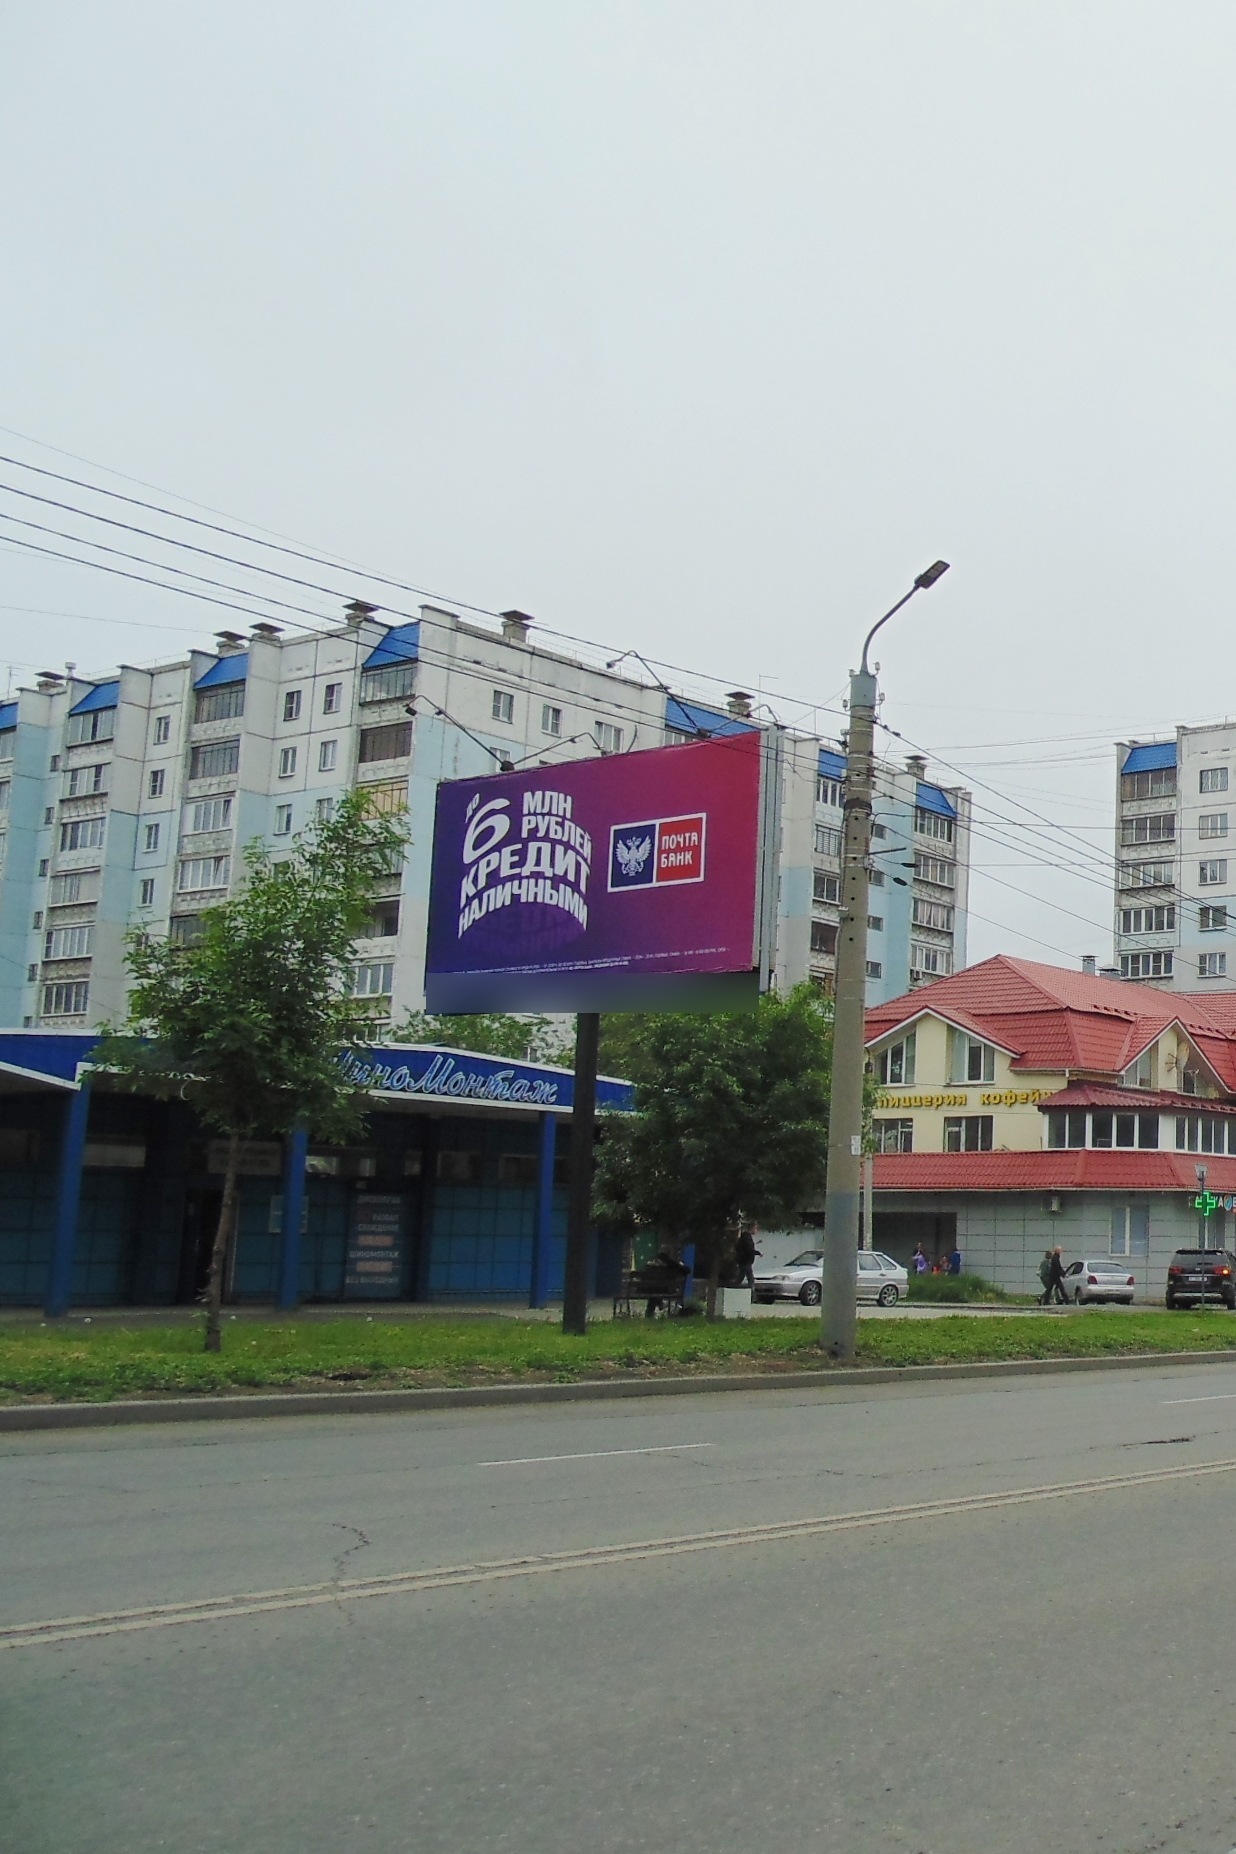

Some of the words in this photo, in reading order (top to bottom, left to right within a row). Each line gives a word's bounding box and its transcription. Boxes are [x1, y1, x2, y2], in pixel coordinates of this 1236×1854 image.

[522, 790, 573, 819] МЛН
[462, 798, 511, 865] 6
[521, 815, 592, 865] РУБЛЕЙ
[661, 832, 699, 850] ПОЧТА
[460, 841, 591, 909] КРЕДИТ
[660, 850, 693, 868] БАНК
[458, 878, 589, 939] НАЛИЧНЫМИ
